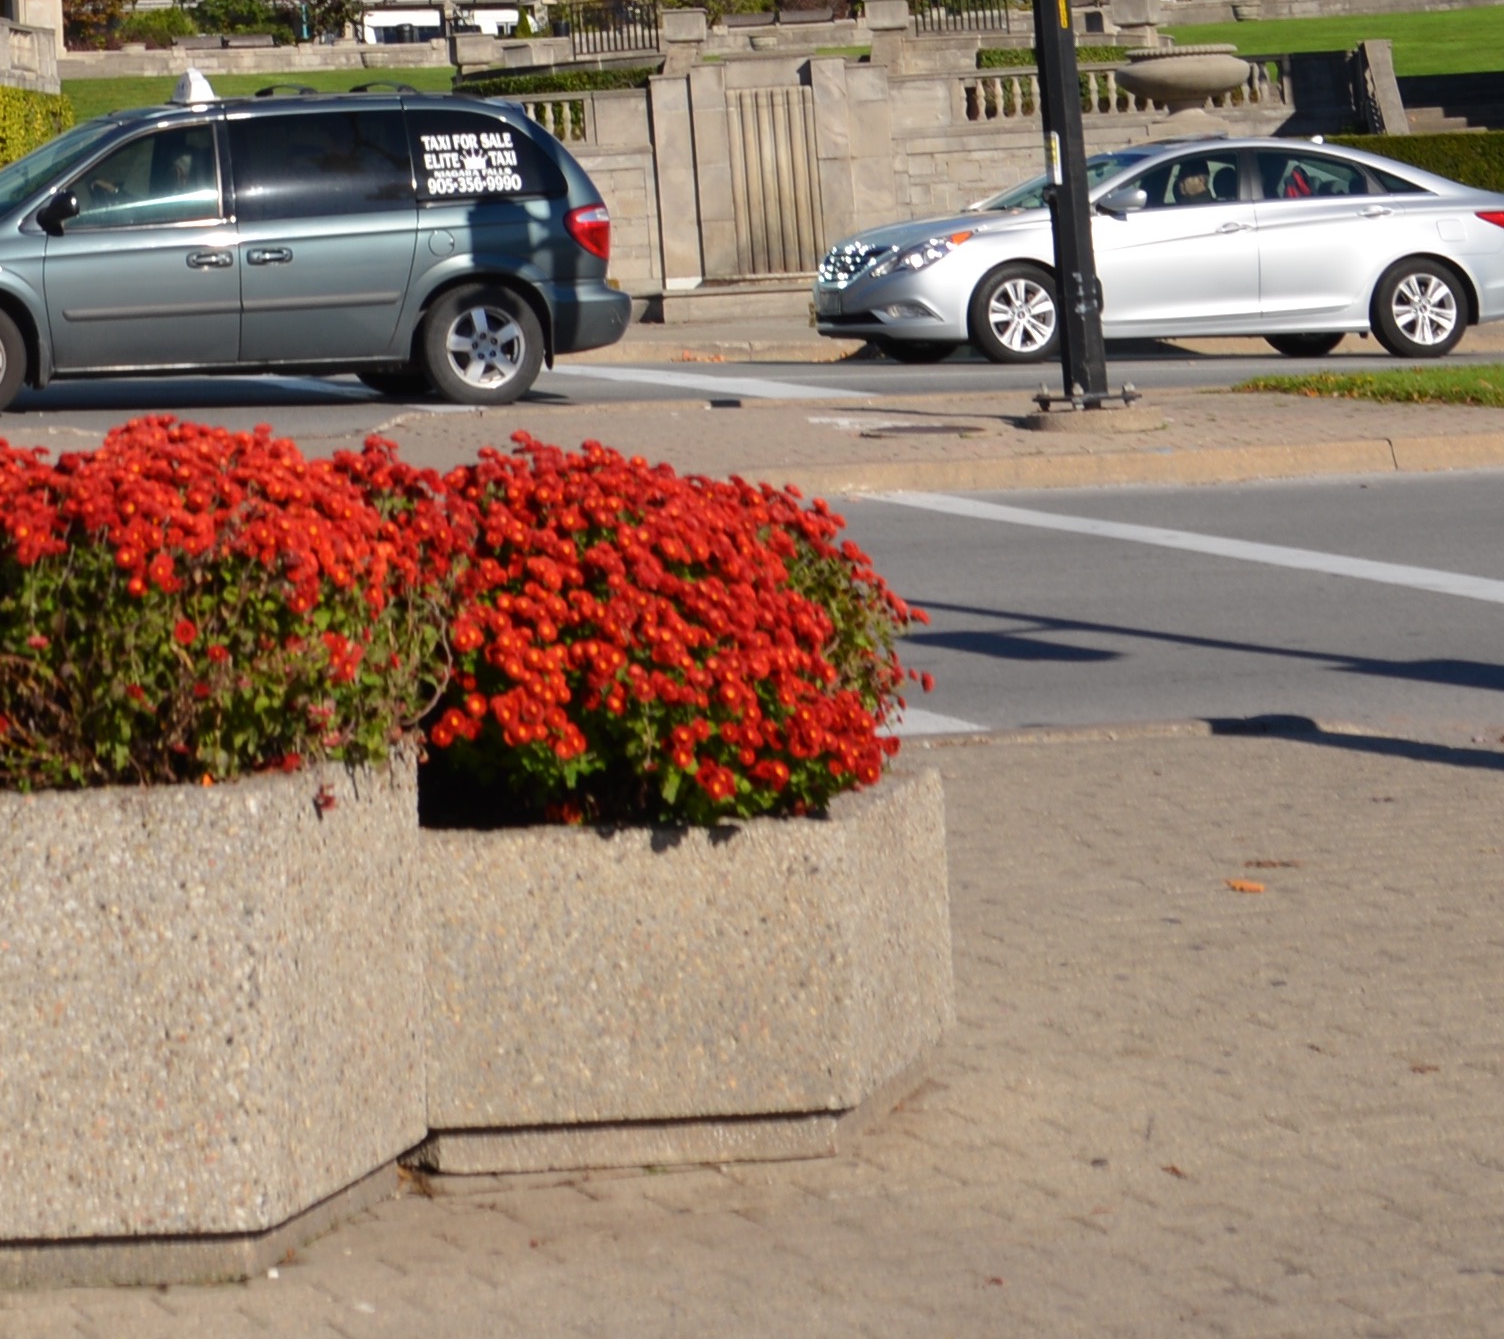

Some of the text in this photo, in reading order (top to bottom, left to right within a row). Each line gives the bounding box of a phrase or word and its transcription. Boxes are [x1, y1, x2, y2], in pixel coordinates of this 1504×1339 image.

[420, 132, 514, 152] TAXI FOR SALE
[423, 149, 518, 171] ELITE TAXI
